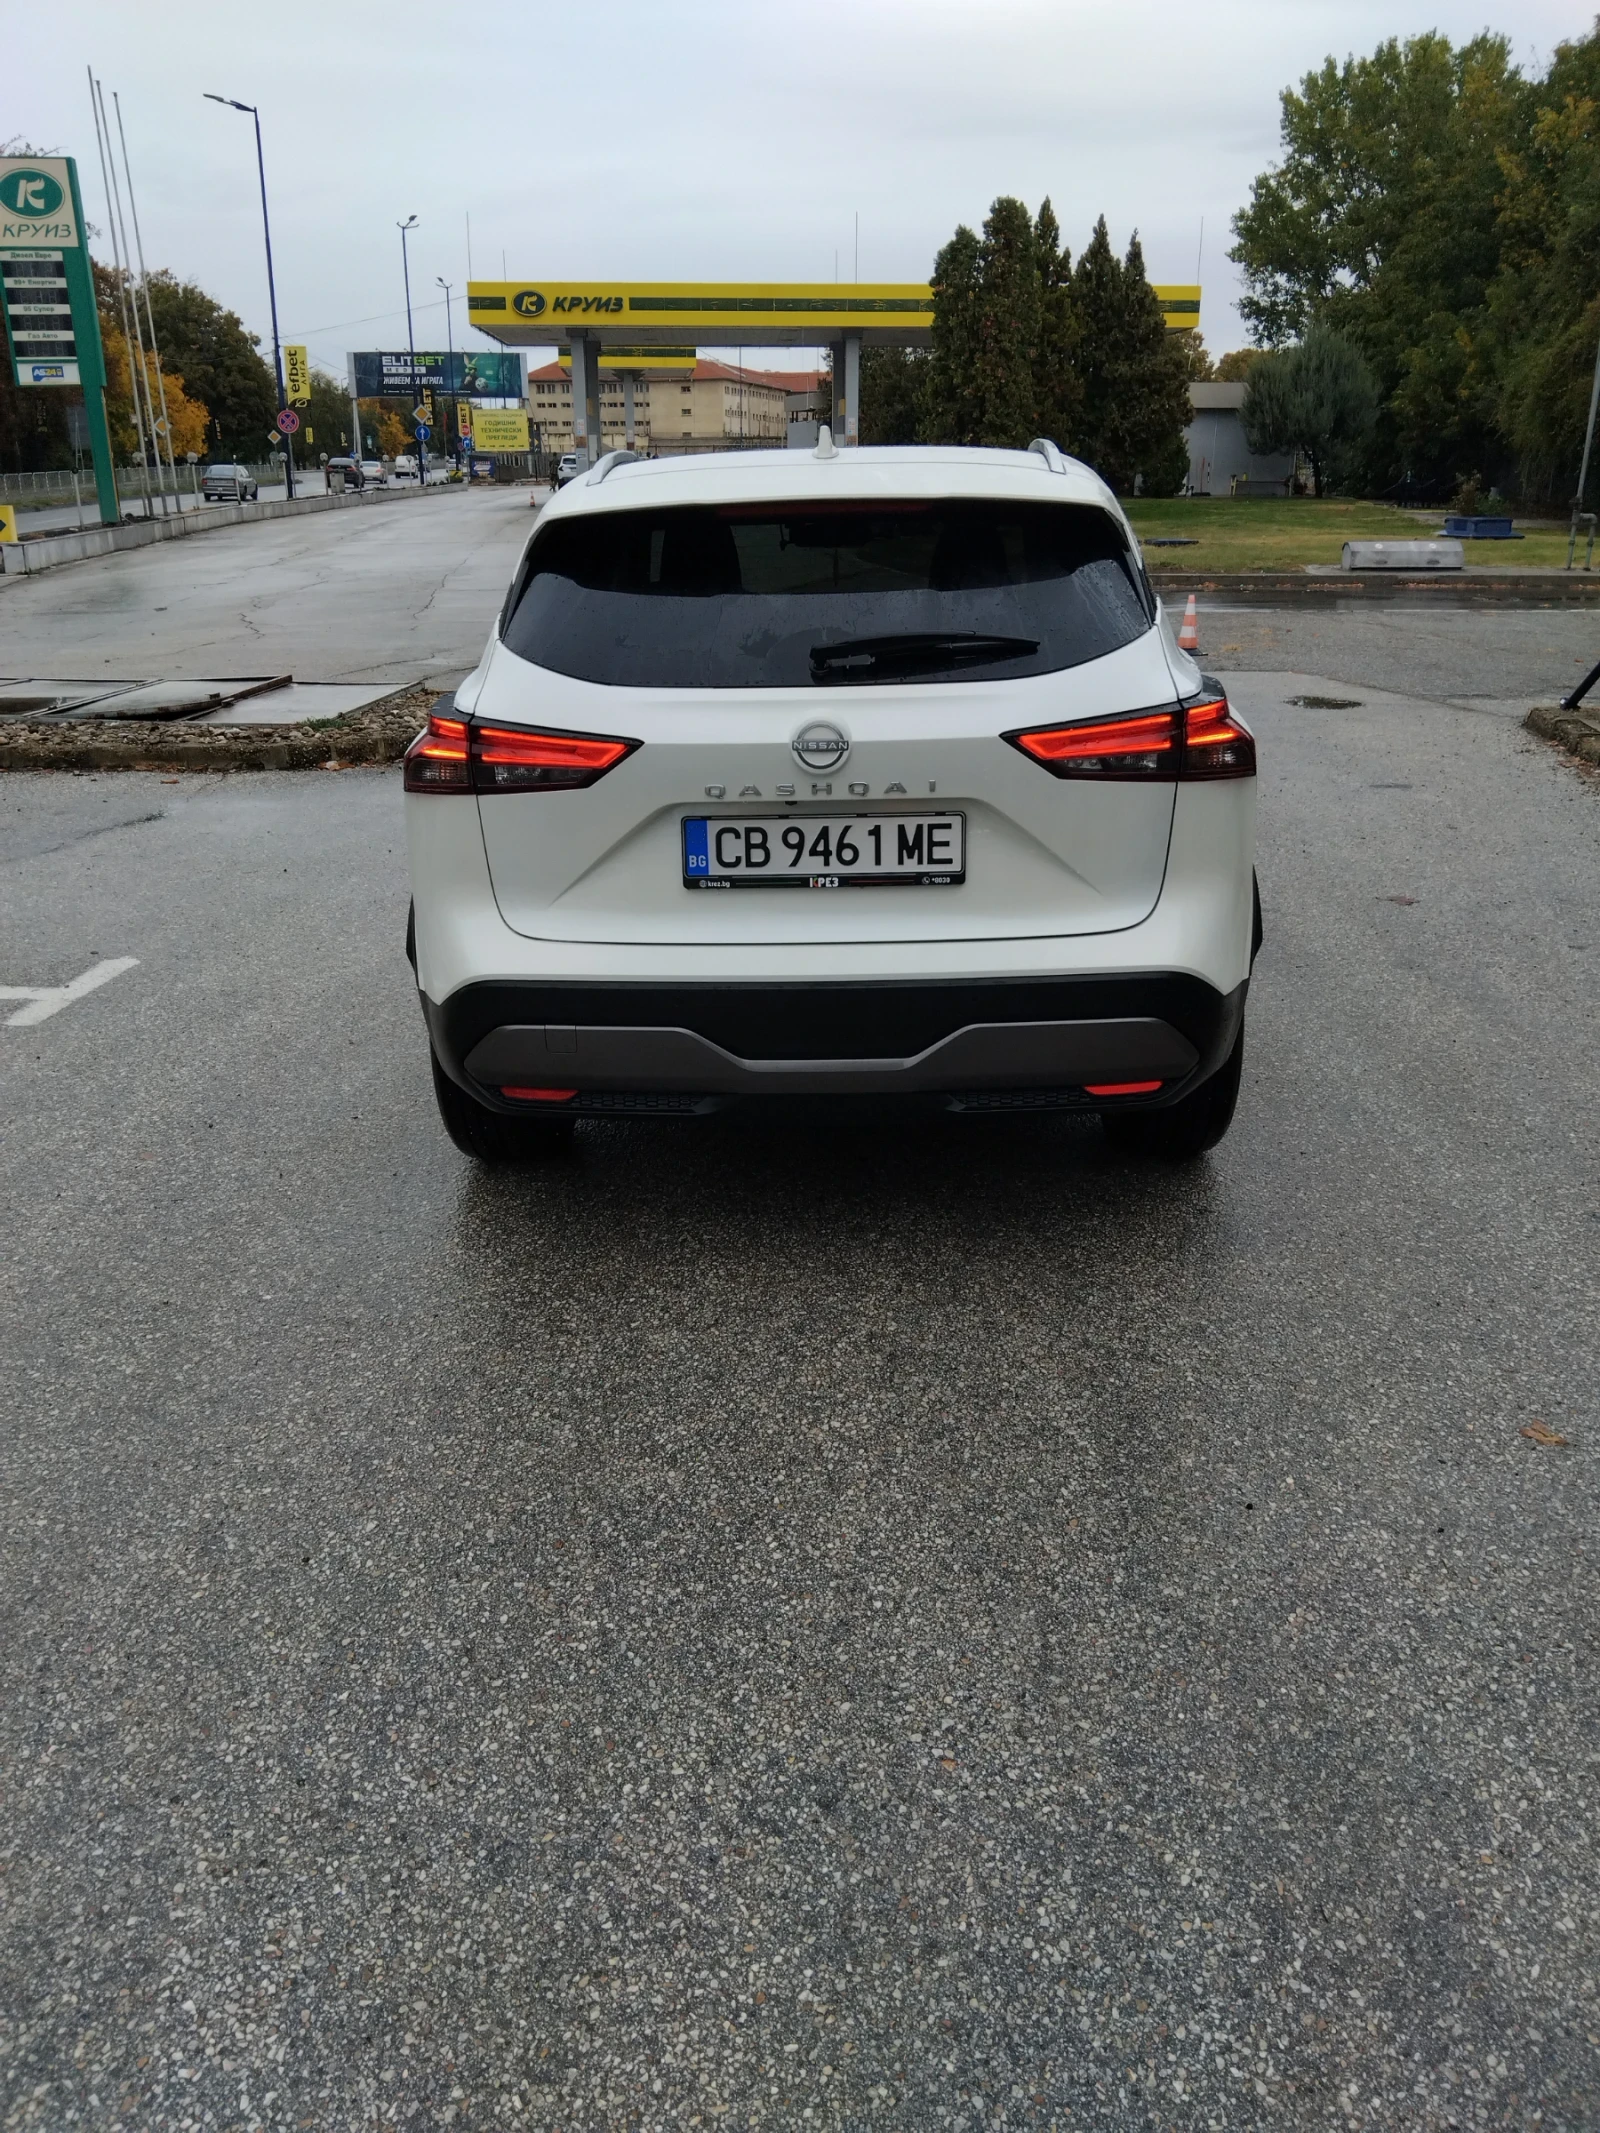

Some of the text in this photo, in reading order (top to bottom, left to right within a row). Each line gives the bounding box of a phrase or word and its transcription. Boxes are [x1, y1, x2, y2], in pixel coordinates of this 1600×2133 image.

[2, 223, 72, 238] КРУИЗ
[552, 296, 624, 312] КРУИЗ
[382, 355, 444, 366] ELITBET
[287, 349, 300, 393] efbet
[383, 376, 411, 385] ЖИВЕЕМ
[421, 376, 444, 385] ИГРАТА
[793, 741, 848, 750] NISSAN
[704, 779, 936, 799] QASHQAI
[715, 823, 953, 869] CB 9461 ME
[688, 855, 707, 868] BG
[707, 880, 731, 888] krez.bg
